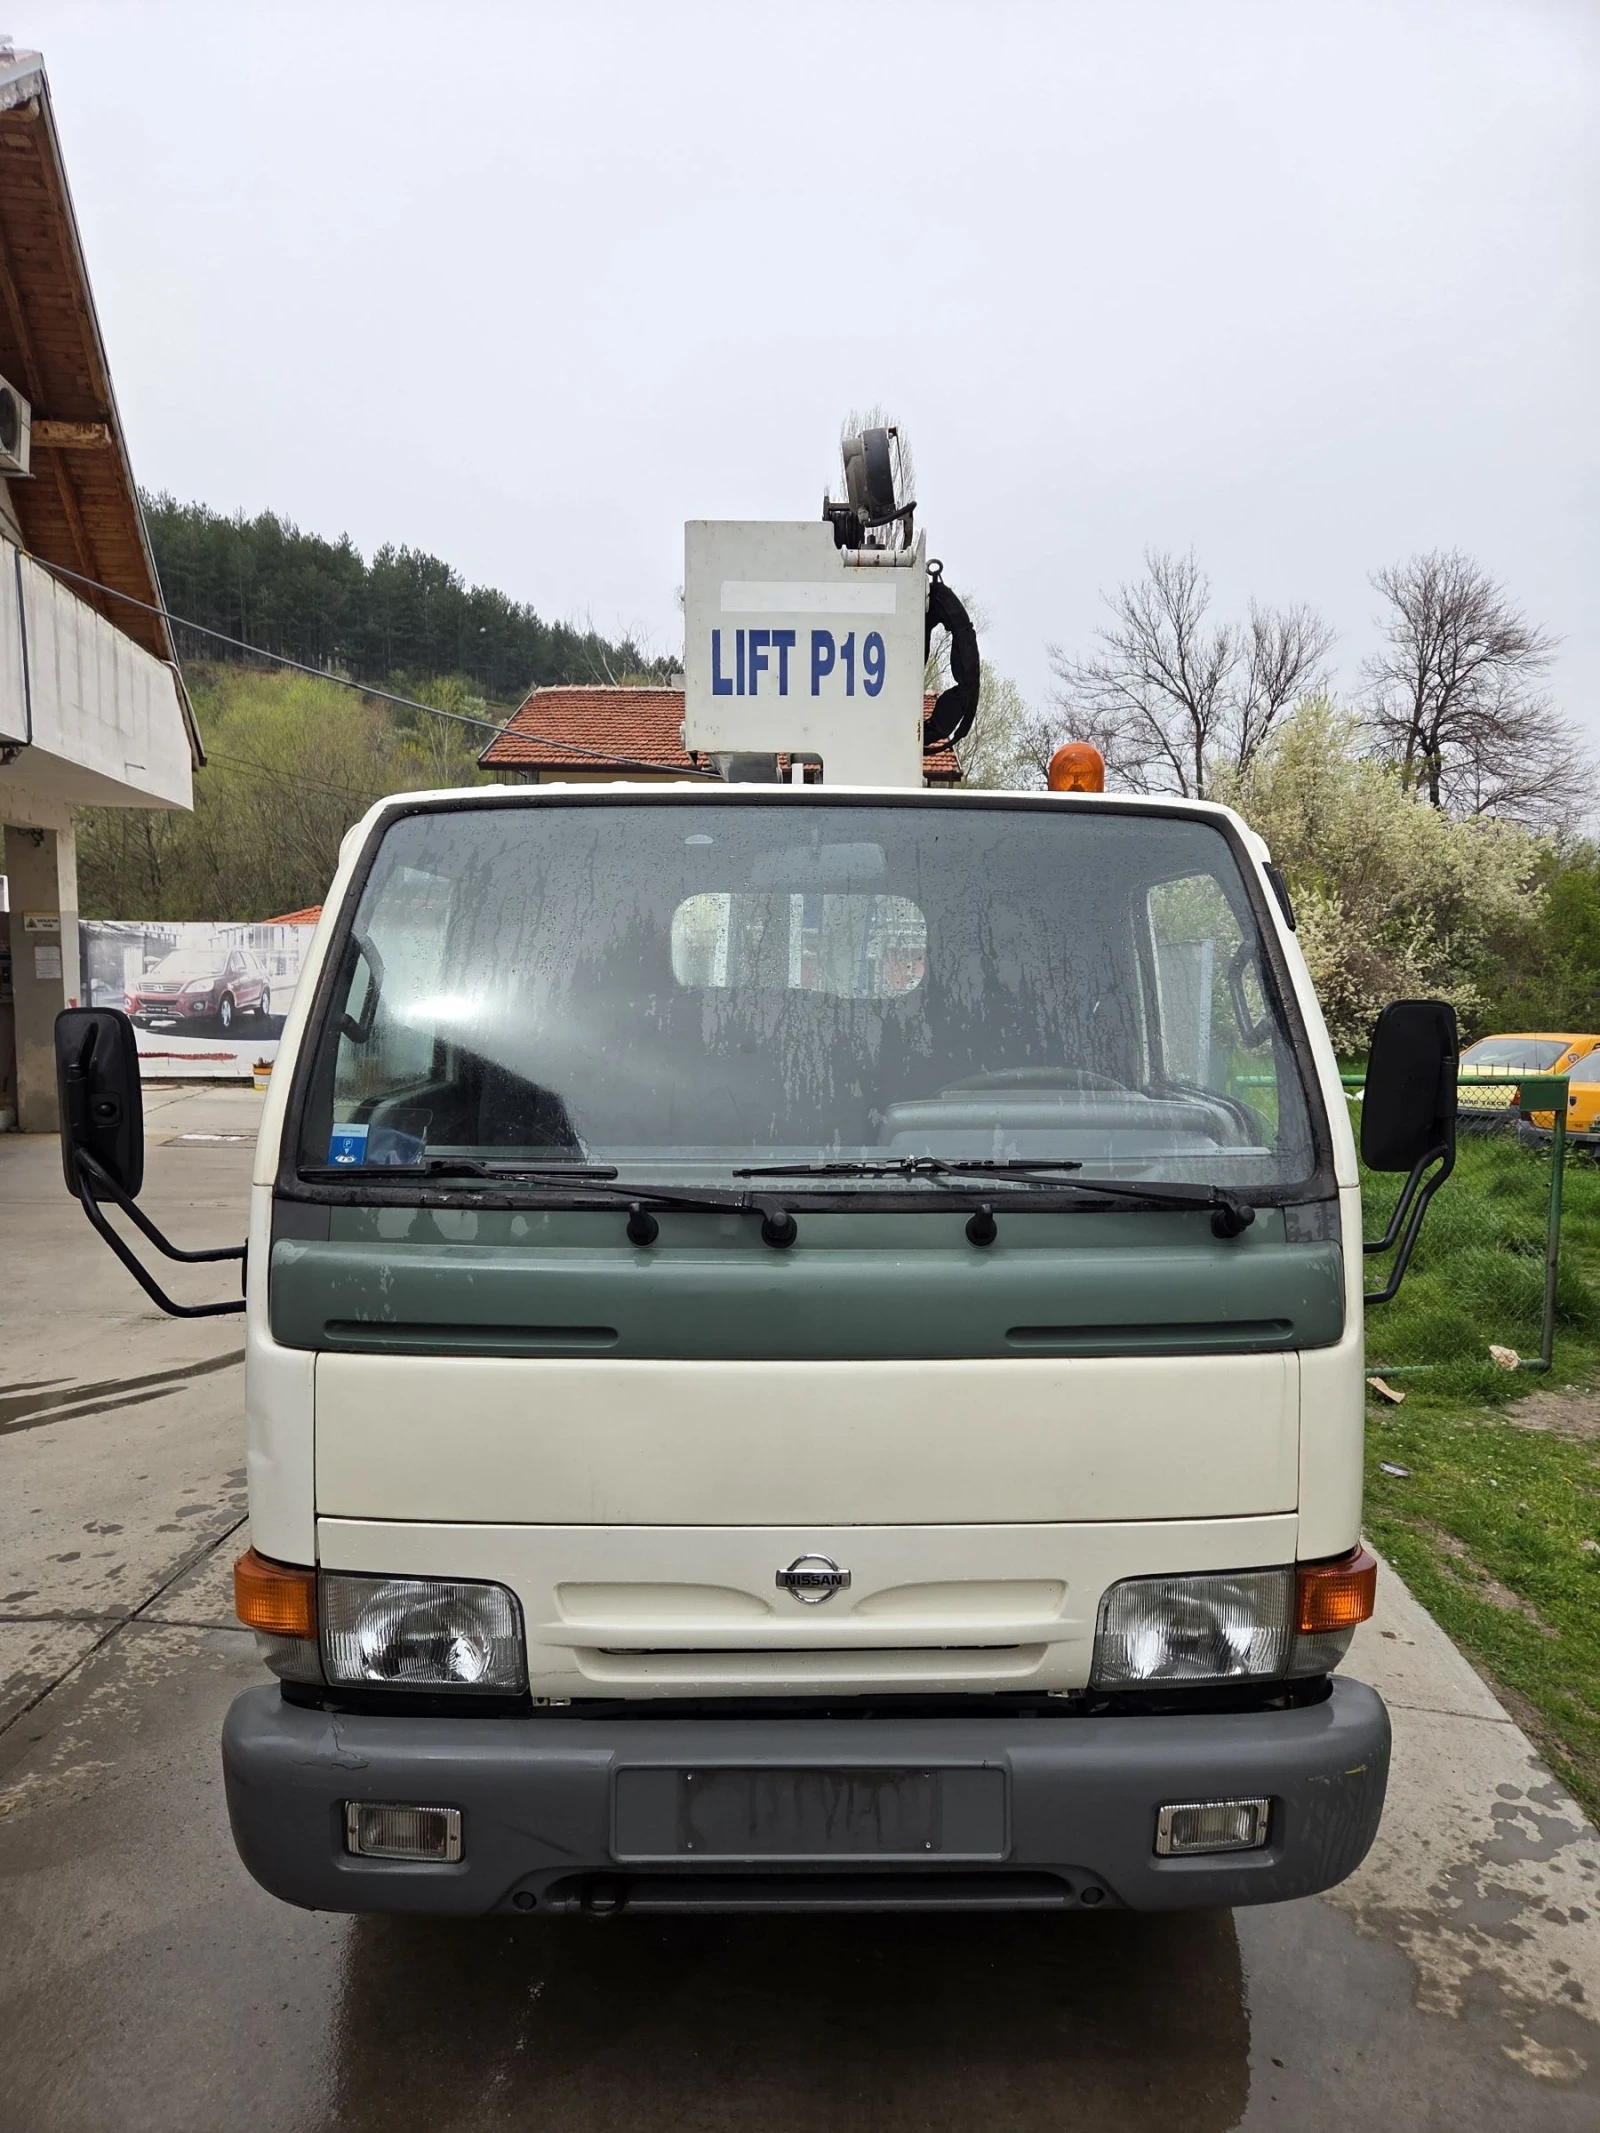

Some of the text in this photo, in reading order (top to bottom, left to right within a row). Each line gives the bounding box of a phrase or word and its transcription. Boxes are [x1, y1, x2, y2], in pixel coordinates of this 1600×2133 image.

[711, 629, 886, 697] LIFT P19
[785, 1574, 843, 1585] NISSAN
